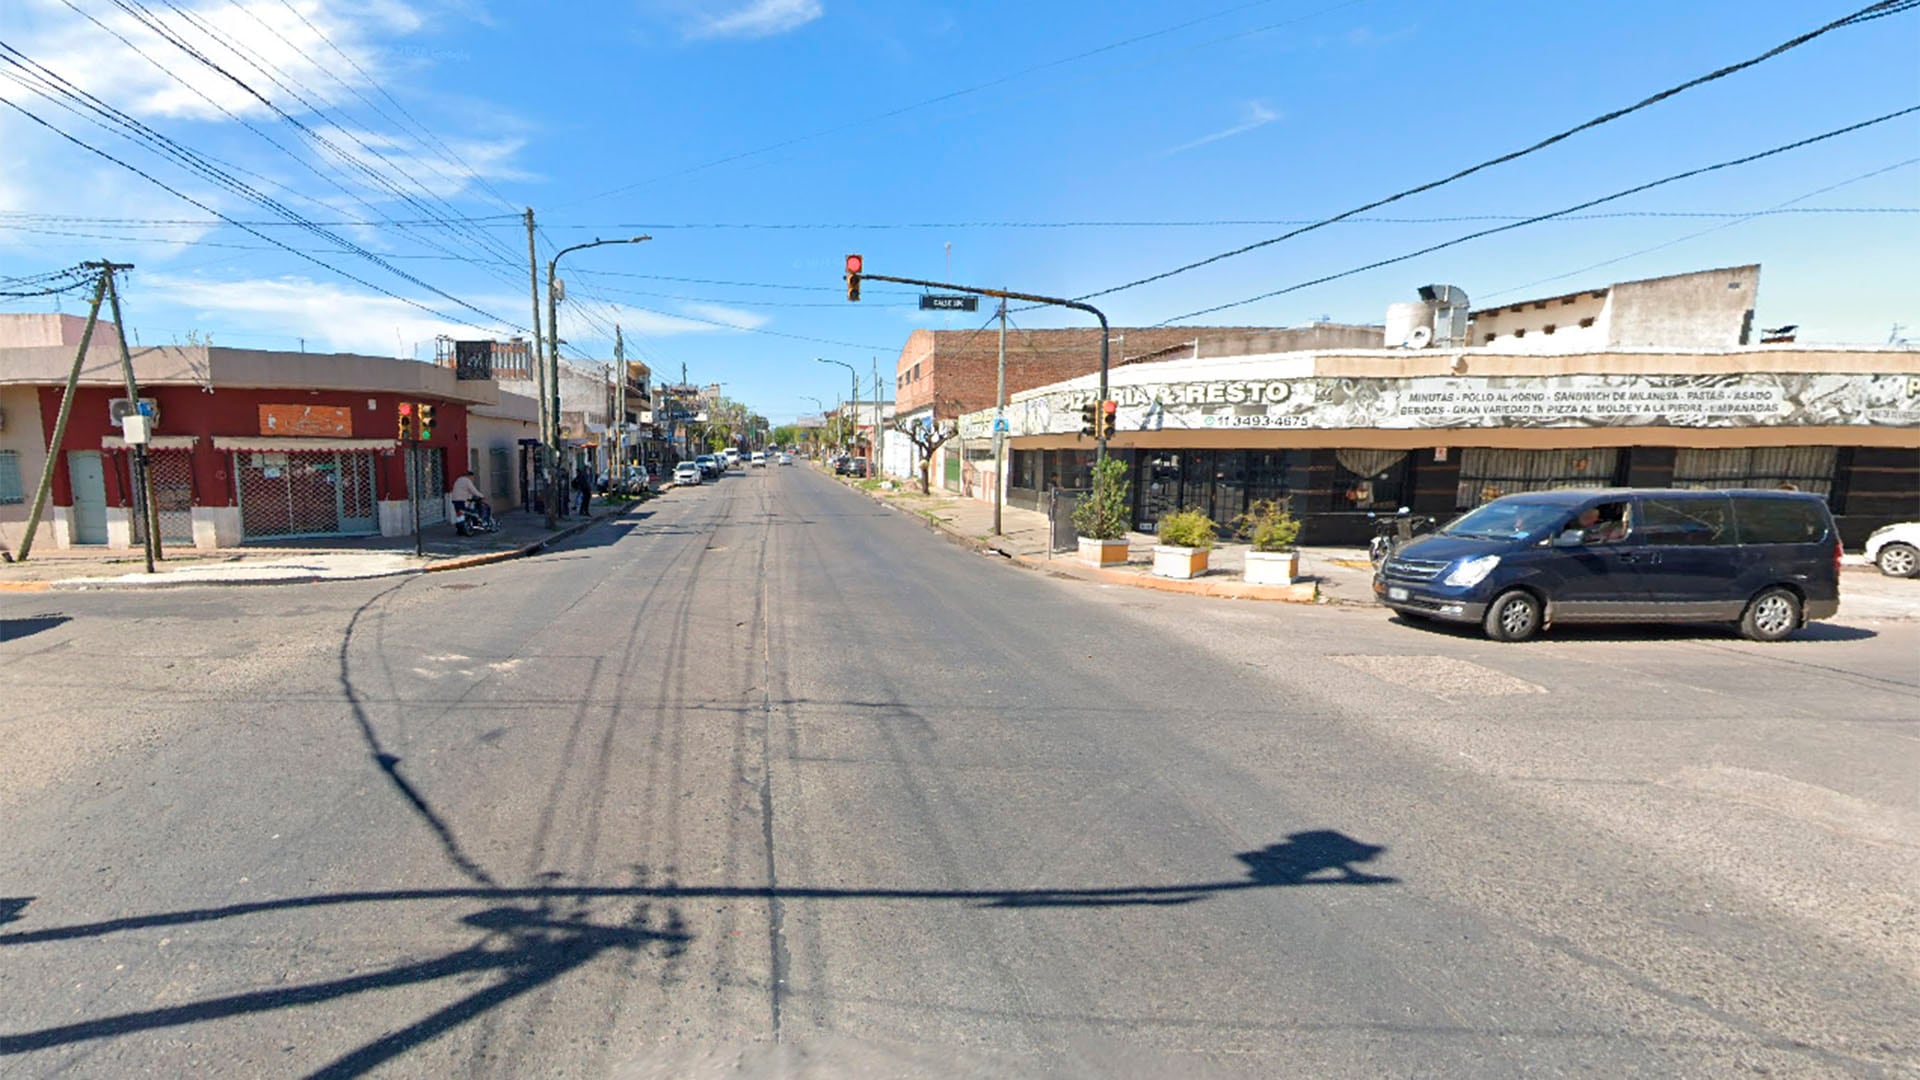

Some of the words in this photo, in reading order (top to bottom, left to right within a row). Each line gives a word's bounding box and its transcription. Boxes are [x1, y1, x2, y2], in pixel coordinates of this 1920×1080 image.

[1061, 388, 1152, 412] PIZZRIA
[1185, 380, 1291, 404] RESTO
[1408, 392, 1454, 402] MINUTAS
[1462, 392, 1495, 402] POLLO
[1497, 392, 1508, 402] AL
[1554, 391, 1610, 401] SANDWICH
[1613, 391, 1625, 400] DE
[1628, 391, 1679, 401] MILANESA
[1687, 391, 1725, 400] PASTAS
[1733, 391, 1773, 400] ASADO
[1400, 406, 1445, 415] BEBIDAS
[1452, 405, 1480, 414] GRAN
[1483, 405, 1530, 414] VARIEDAD
[1547, 404, 1578, 413] PIZZA
[1597, 404, 1632, 413] MOLDE
[1643, 404, 1651, 412] A
[1653, 404, 1665, 413] LA
[1709, 403, 1778, 412] EMPANADAS
